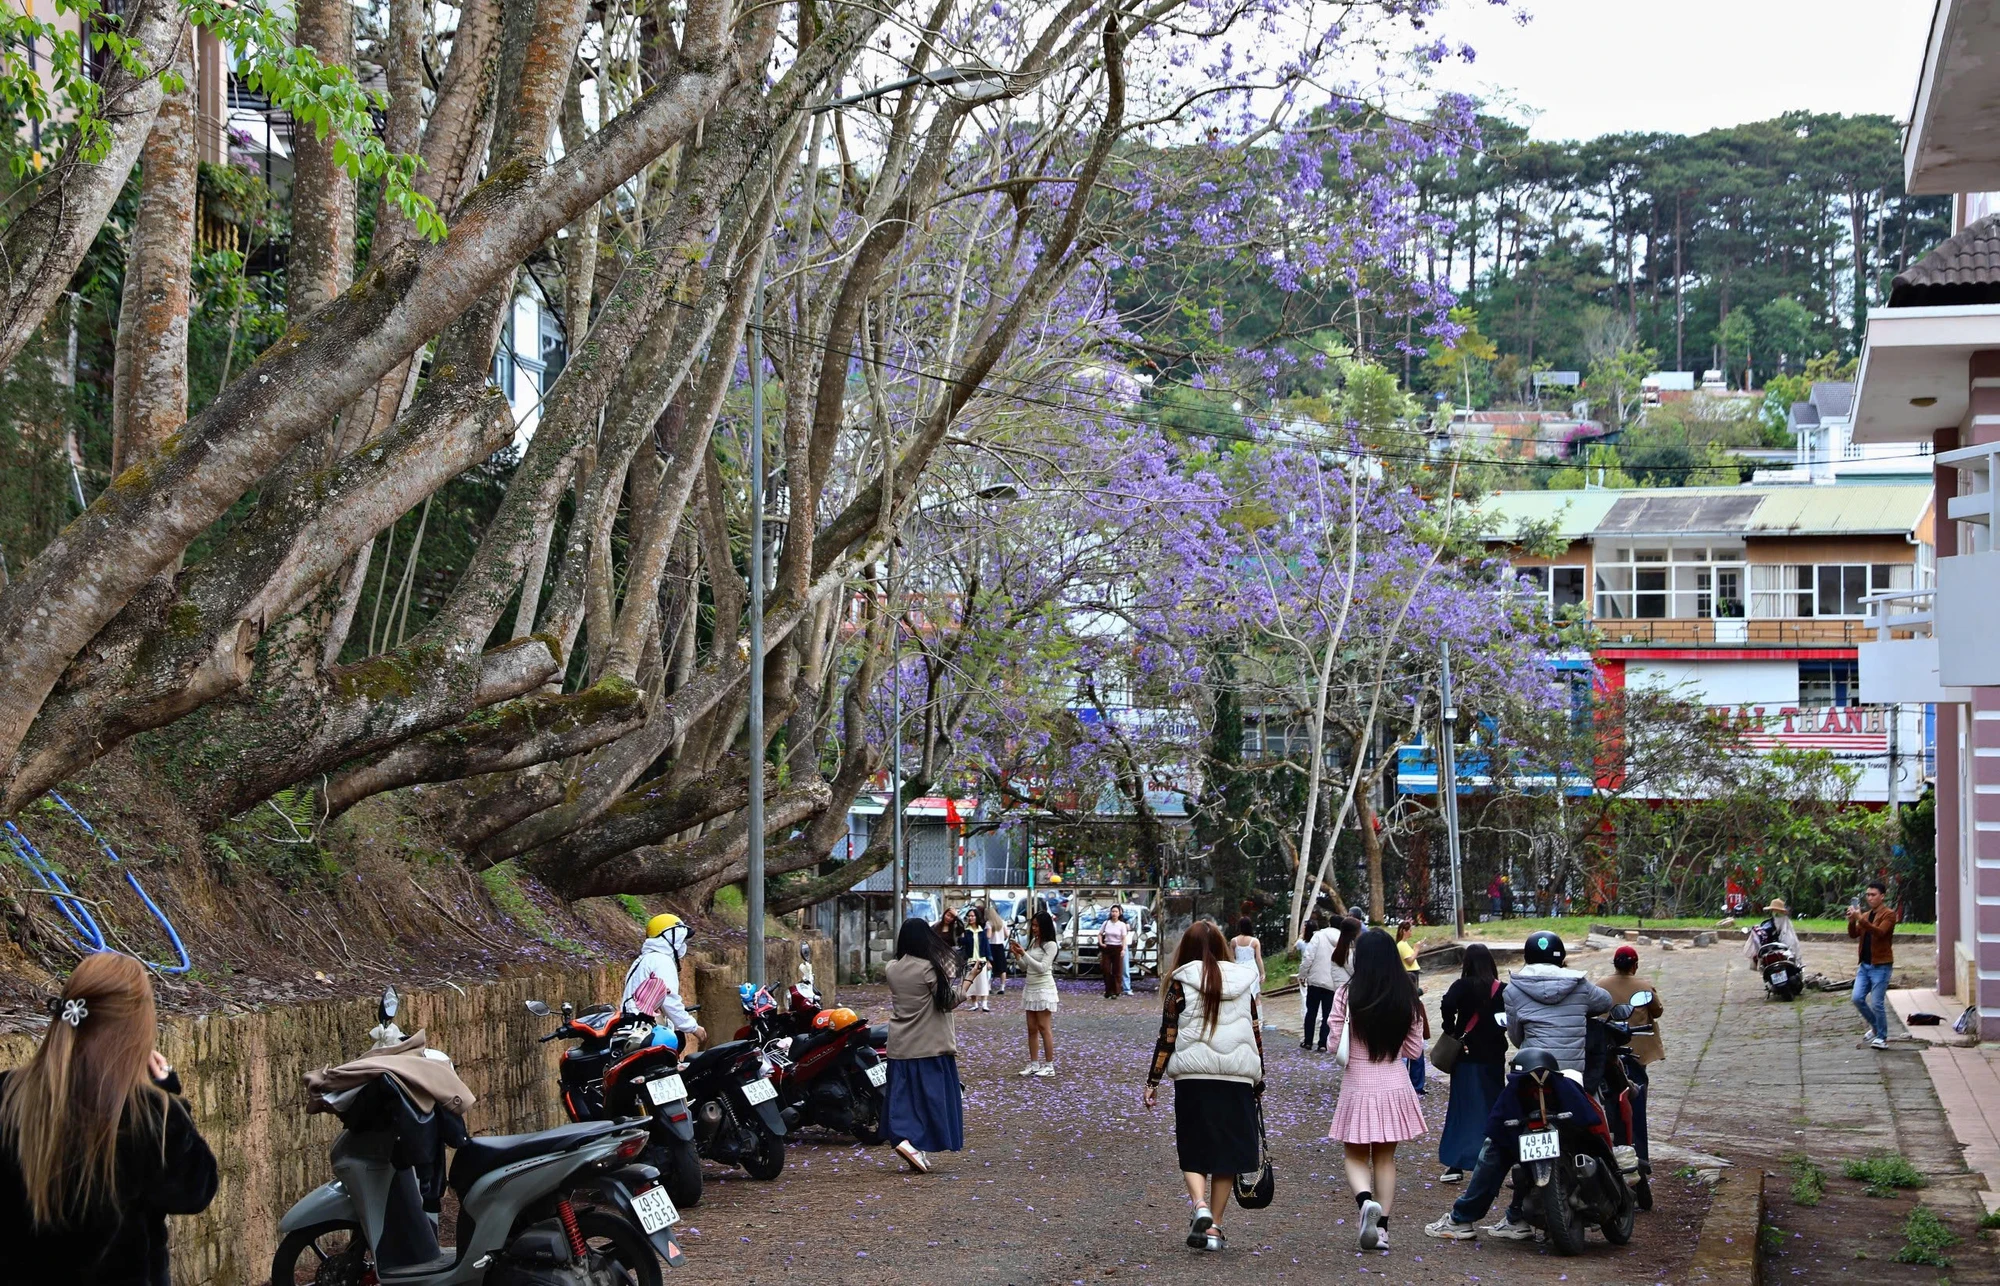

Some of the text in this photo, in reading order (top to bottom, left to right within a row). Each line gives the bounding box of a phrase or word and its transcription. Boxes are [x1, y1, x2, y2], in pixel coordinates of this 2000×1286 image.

[1779, 706, 1887, 733] THANH
[1525, 1133, 1553, 1147] 49-AA
[1523, 1145, 1557, 1159] 145.24
[639, 1191, 665, 1213] 49-S1
[643, 1205, 677, 1231] 079.53
